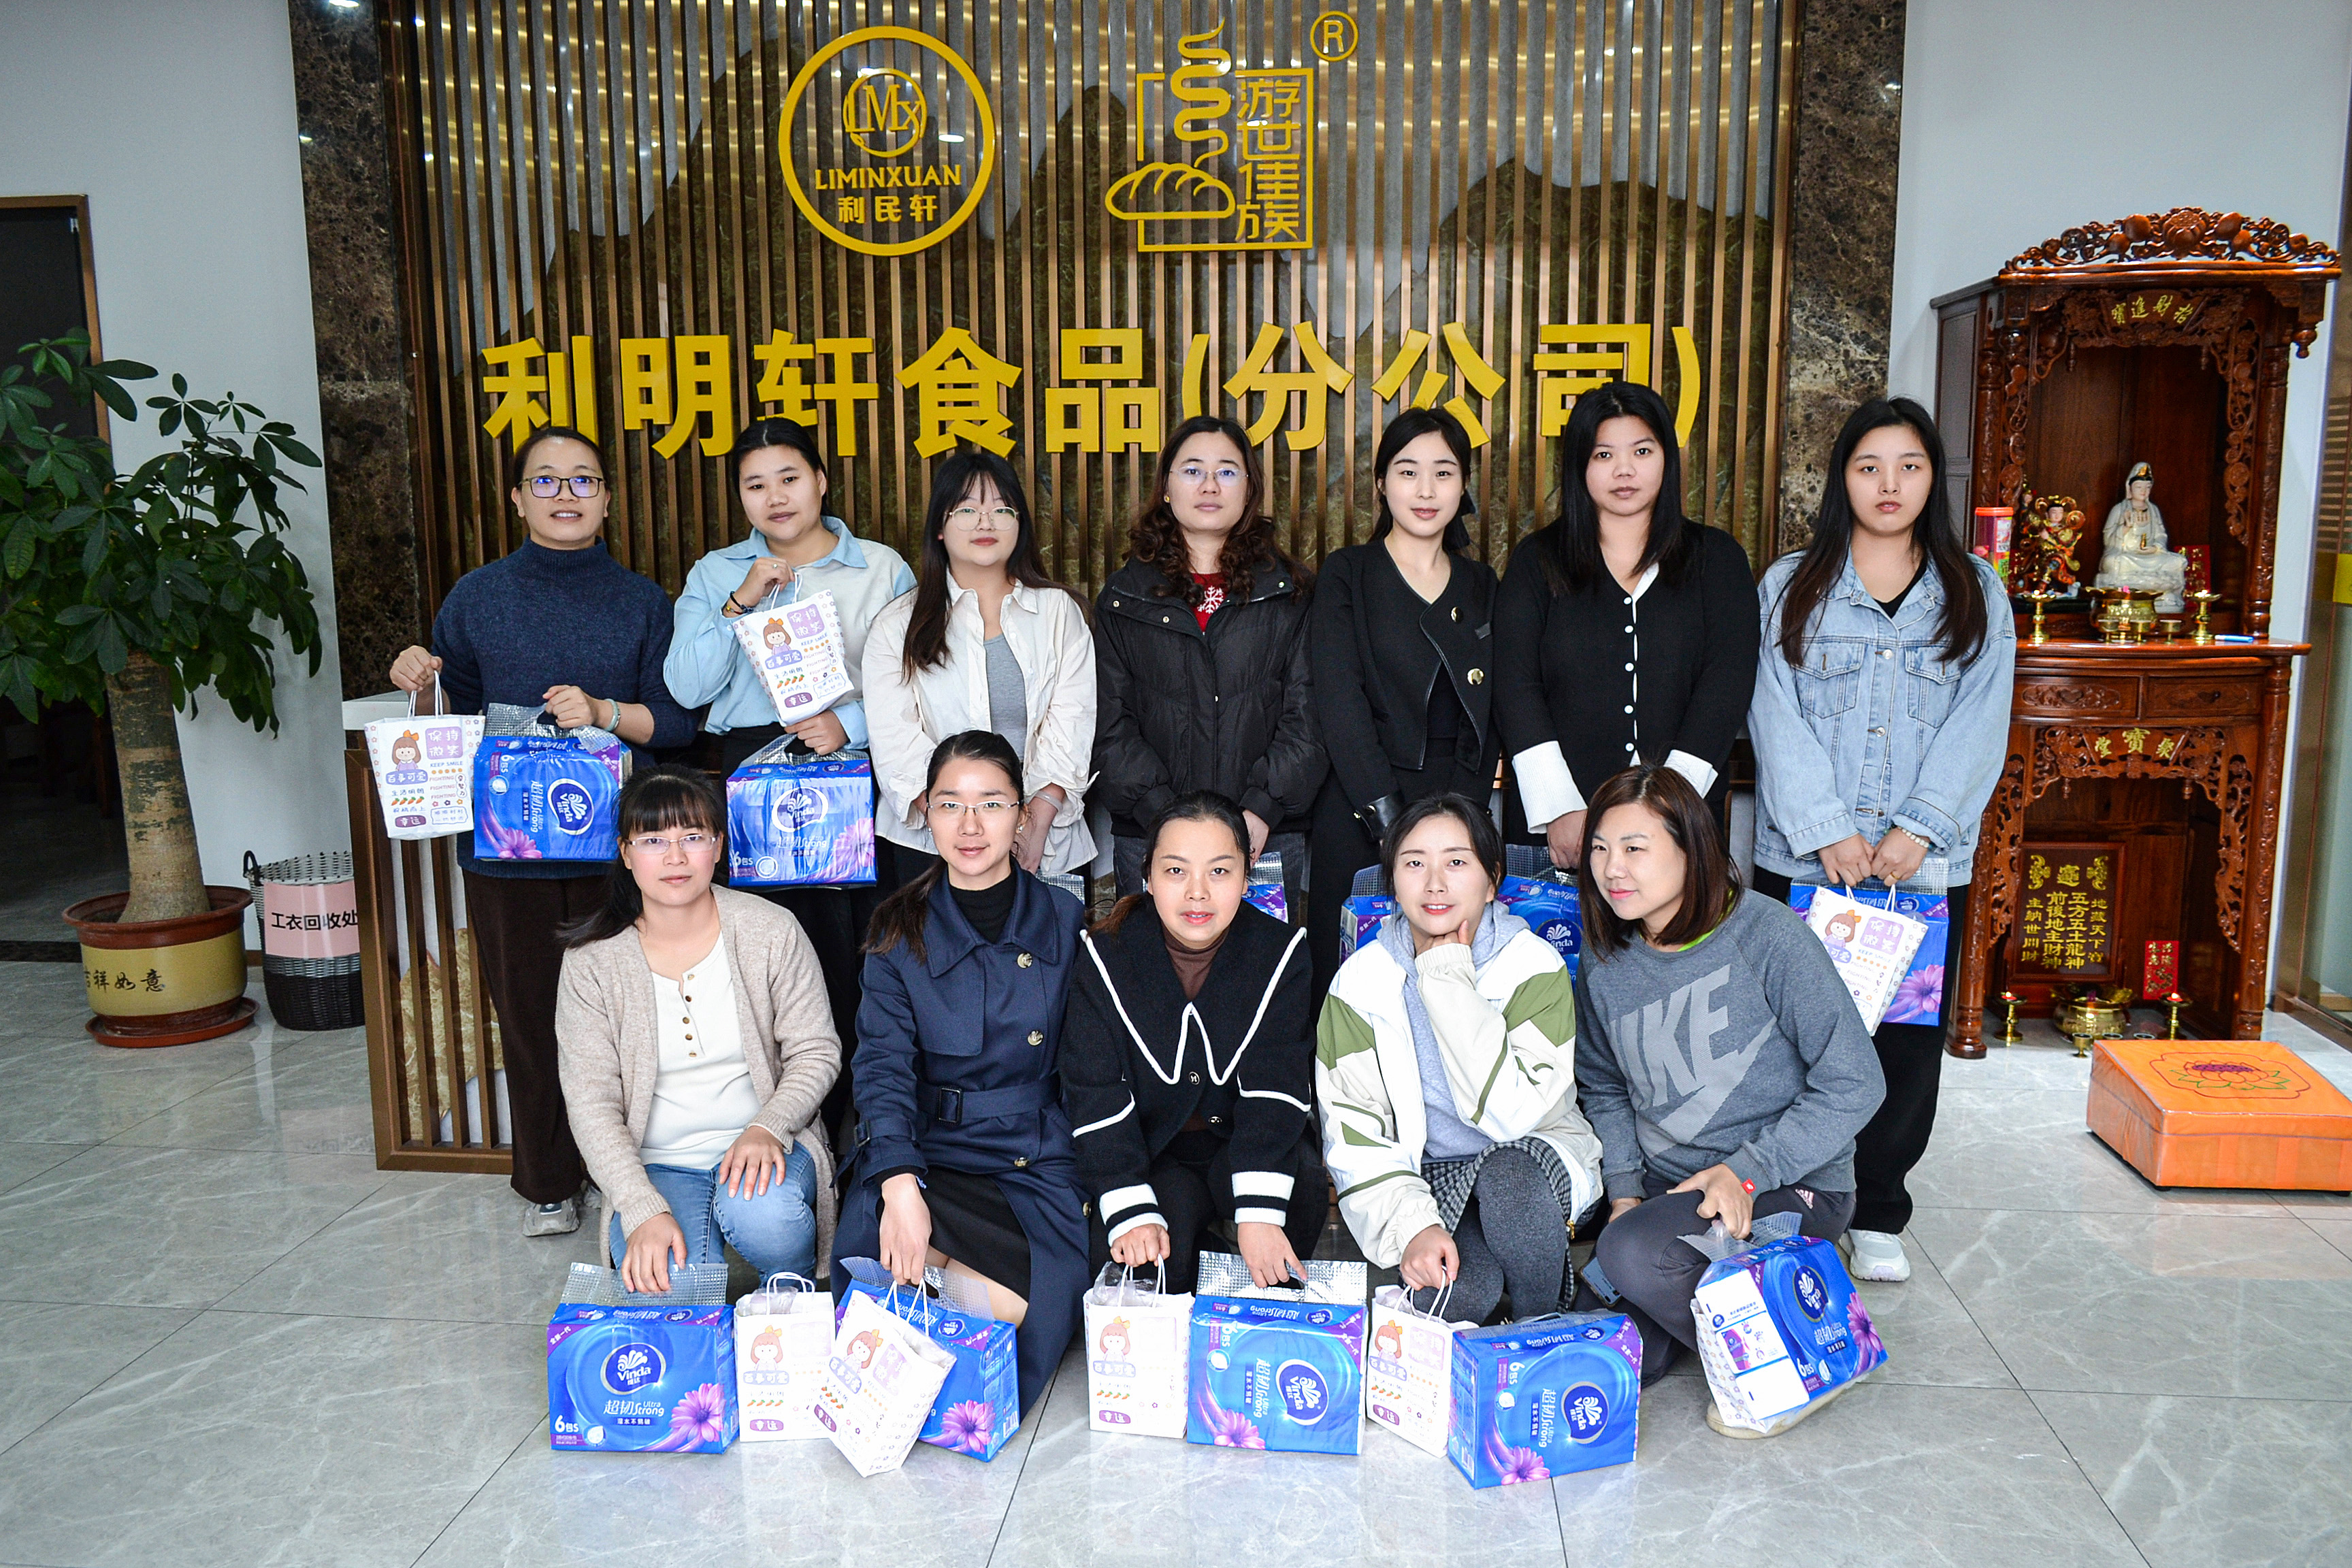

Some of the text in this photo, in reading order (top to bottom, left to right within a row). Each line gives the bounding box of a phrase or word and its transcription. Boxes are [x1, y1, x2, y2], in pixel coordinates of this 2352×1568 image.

[815, 165, 962, 191] LIMINXUAN
[837, 195, 938, 225] 利民轩
[428, 730, 459, 742] 保持
[429, 745, 459, 757] 微笑
[559, 793, 573, 823] Vinda
[788, 806, 815, 821] Vinda
[400, 817, 421, 827] 幸运
[272, 910, 358, 932] 工衣回收处
[1550, 938, 1573, 948] inda
[617, 1366, 652, 1382] Vinda
[1253, 1358, 1271, 1418] 超韧 Strong
[1290, 1375, 1303, 1410] Vinda
[603, 1399, 665, 1417] 超韧 Strong
[643, 1400, 661, 1408] Ultra
[1573, 1396, 1587, 1431] Vinda
[1538, 1388, 1556, 1448] 超韧 Strong
